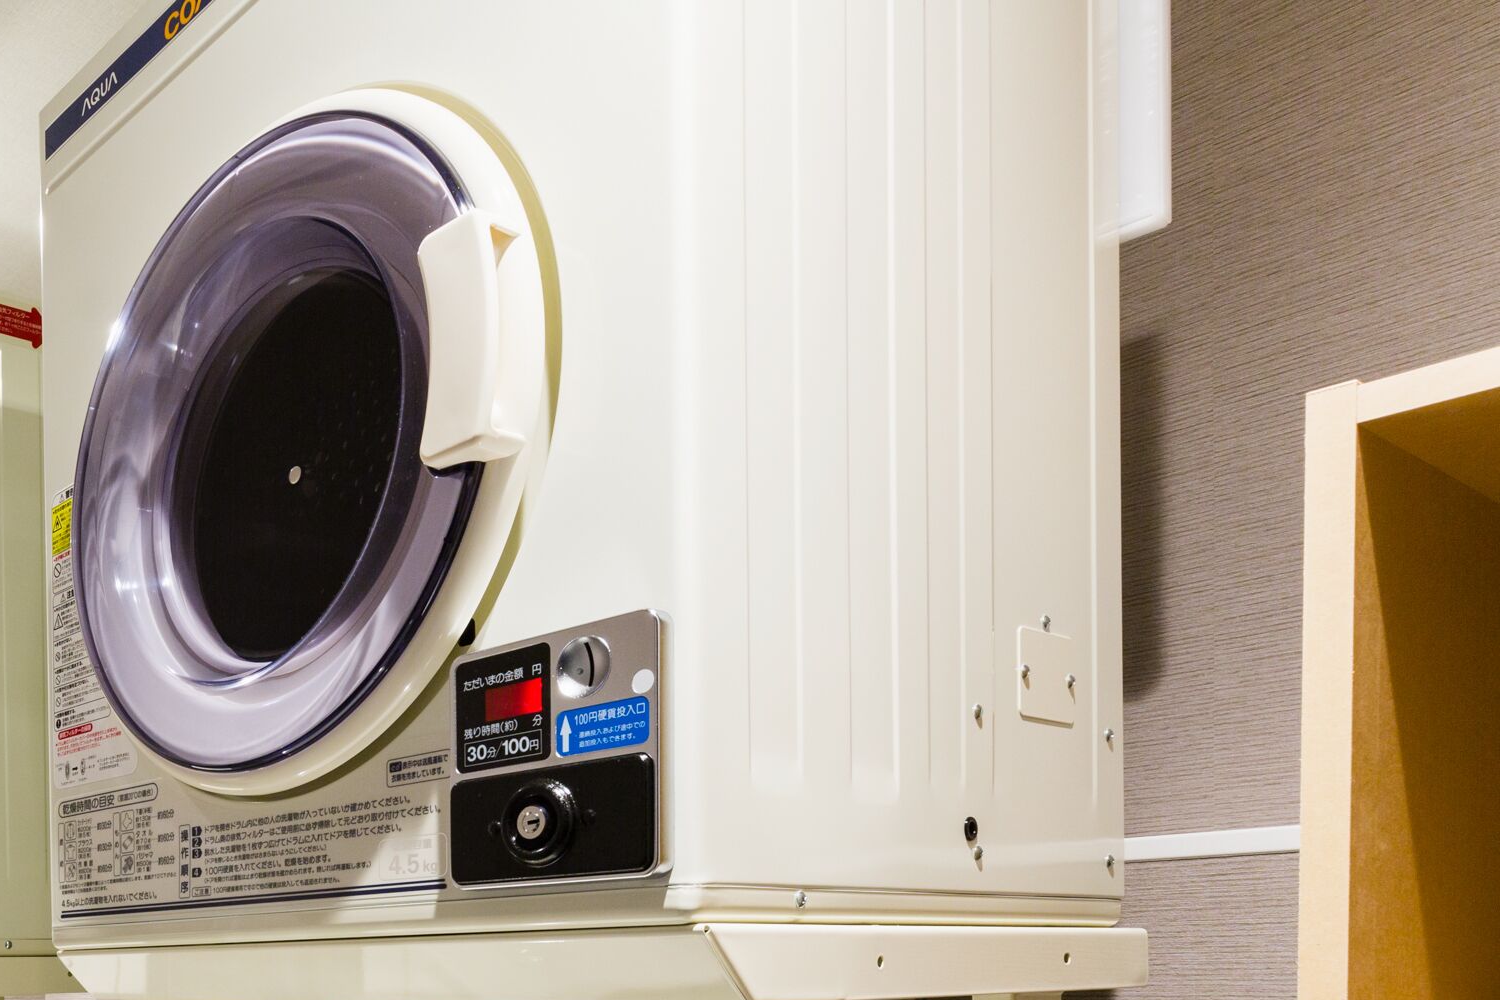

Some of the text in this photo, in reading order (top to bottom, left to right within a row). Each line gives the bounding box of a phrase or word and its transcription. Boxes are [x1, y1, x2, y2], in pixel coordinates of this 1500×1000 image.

[81, 71, 118, 116] AQUA
[463, 663, 543, 692] ただいまの金額 円
[532, 714, 543, 727] 分
[574, 702, 646, 726] 100円硬貨投入口
[62, 794, 115, 815] 乾燥時間の目安
